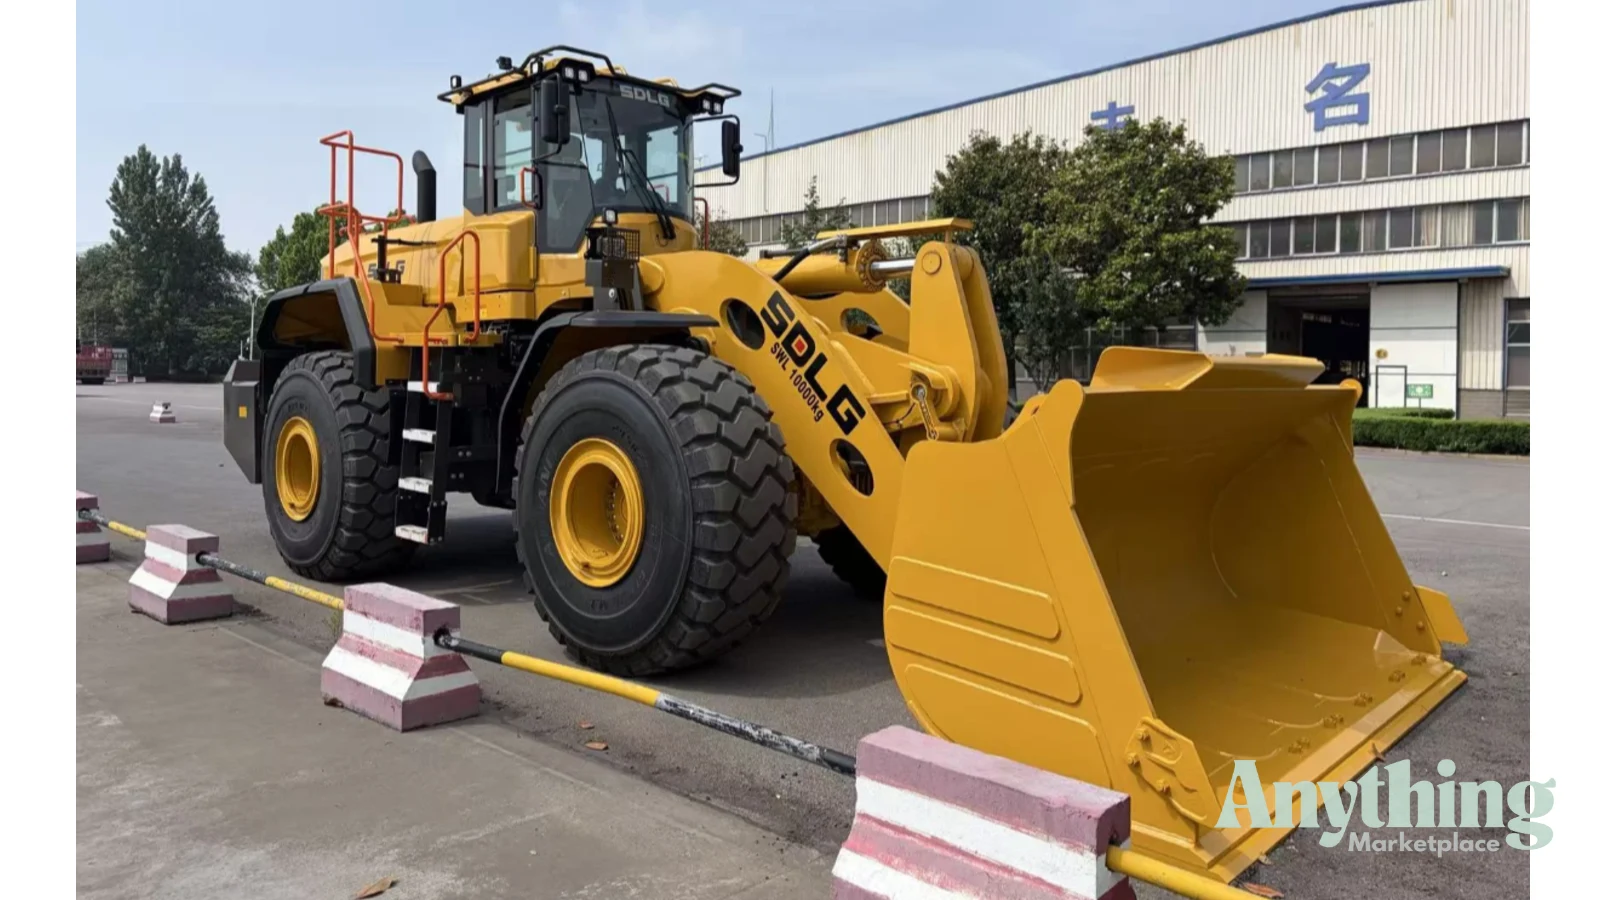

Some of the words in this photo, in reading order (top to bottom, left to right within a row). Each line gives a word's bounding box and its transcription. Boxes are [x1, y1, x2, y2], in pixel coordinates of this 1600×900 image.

[620, 84, 670, 107] SDLG
[1304, 62, 1371, 132] 名
[367, 260, 406, 279] SG
[760, 290, 866, 436] SDLG
[770, 342, 791, 371] SWL
[789, 369, 824, 422] 10000kg
